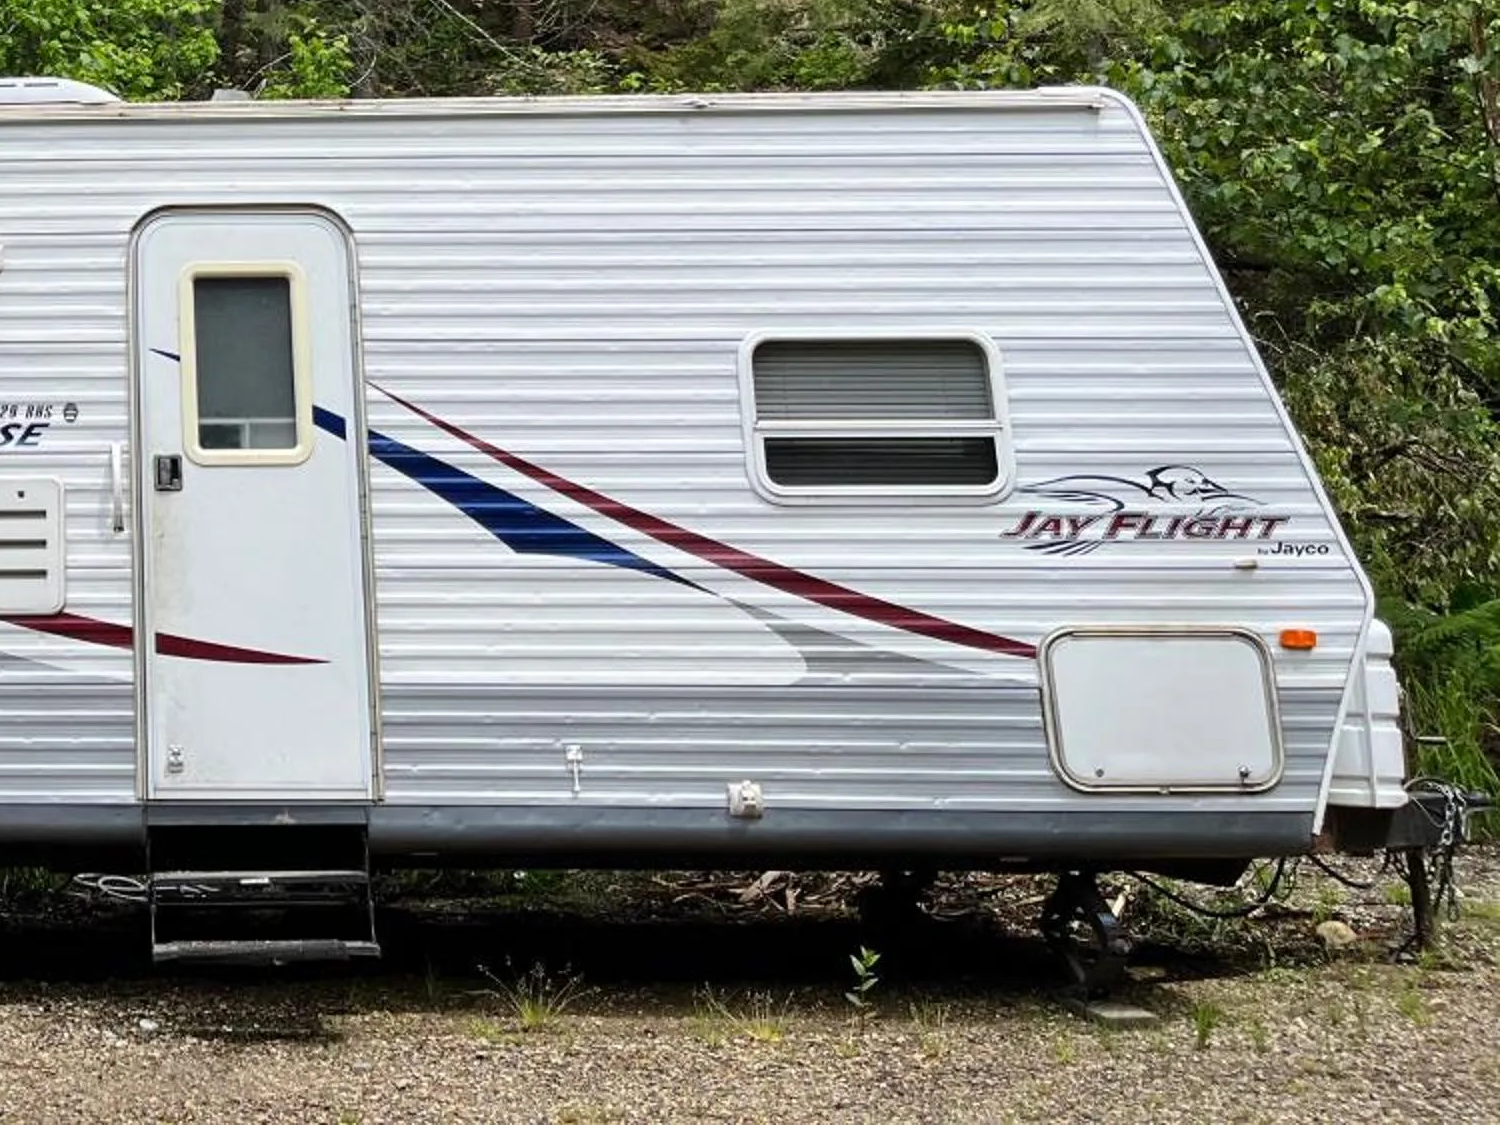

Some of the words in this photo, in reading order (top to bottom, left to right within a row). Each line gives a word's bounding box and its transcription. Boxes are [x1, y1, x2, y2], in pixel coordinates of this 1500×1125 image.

[1001, 510, 1099, 540] JAY
[1102, 512, 1291, 540] FLIGHT
[1271, 541, 1329, 557] Jayco
